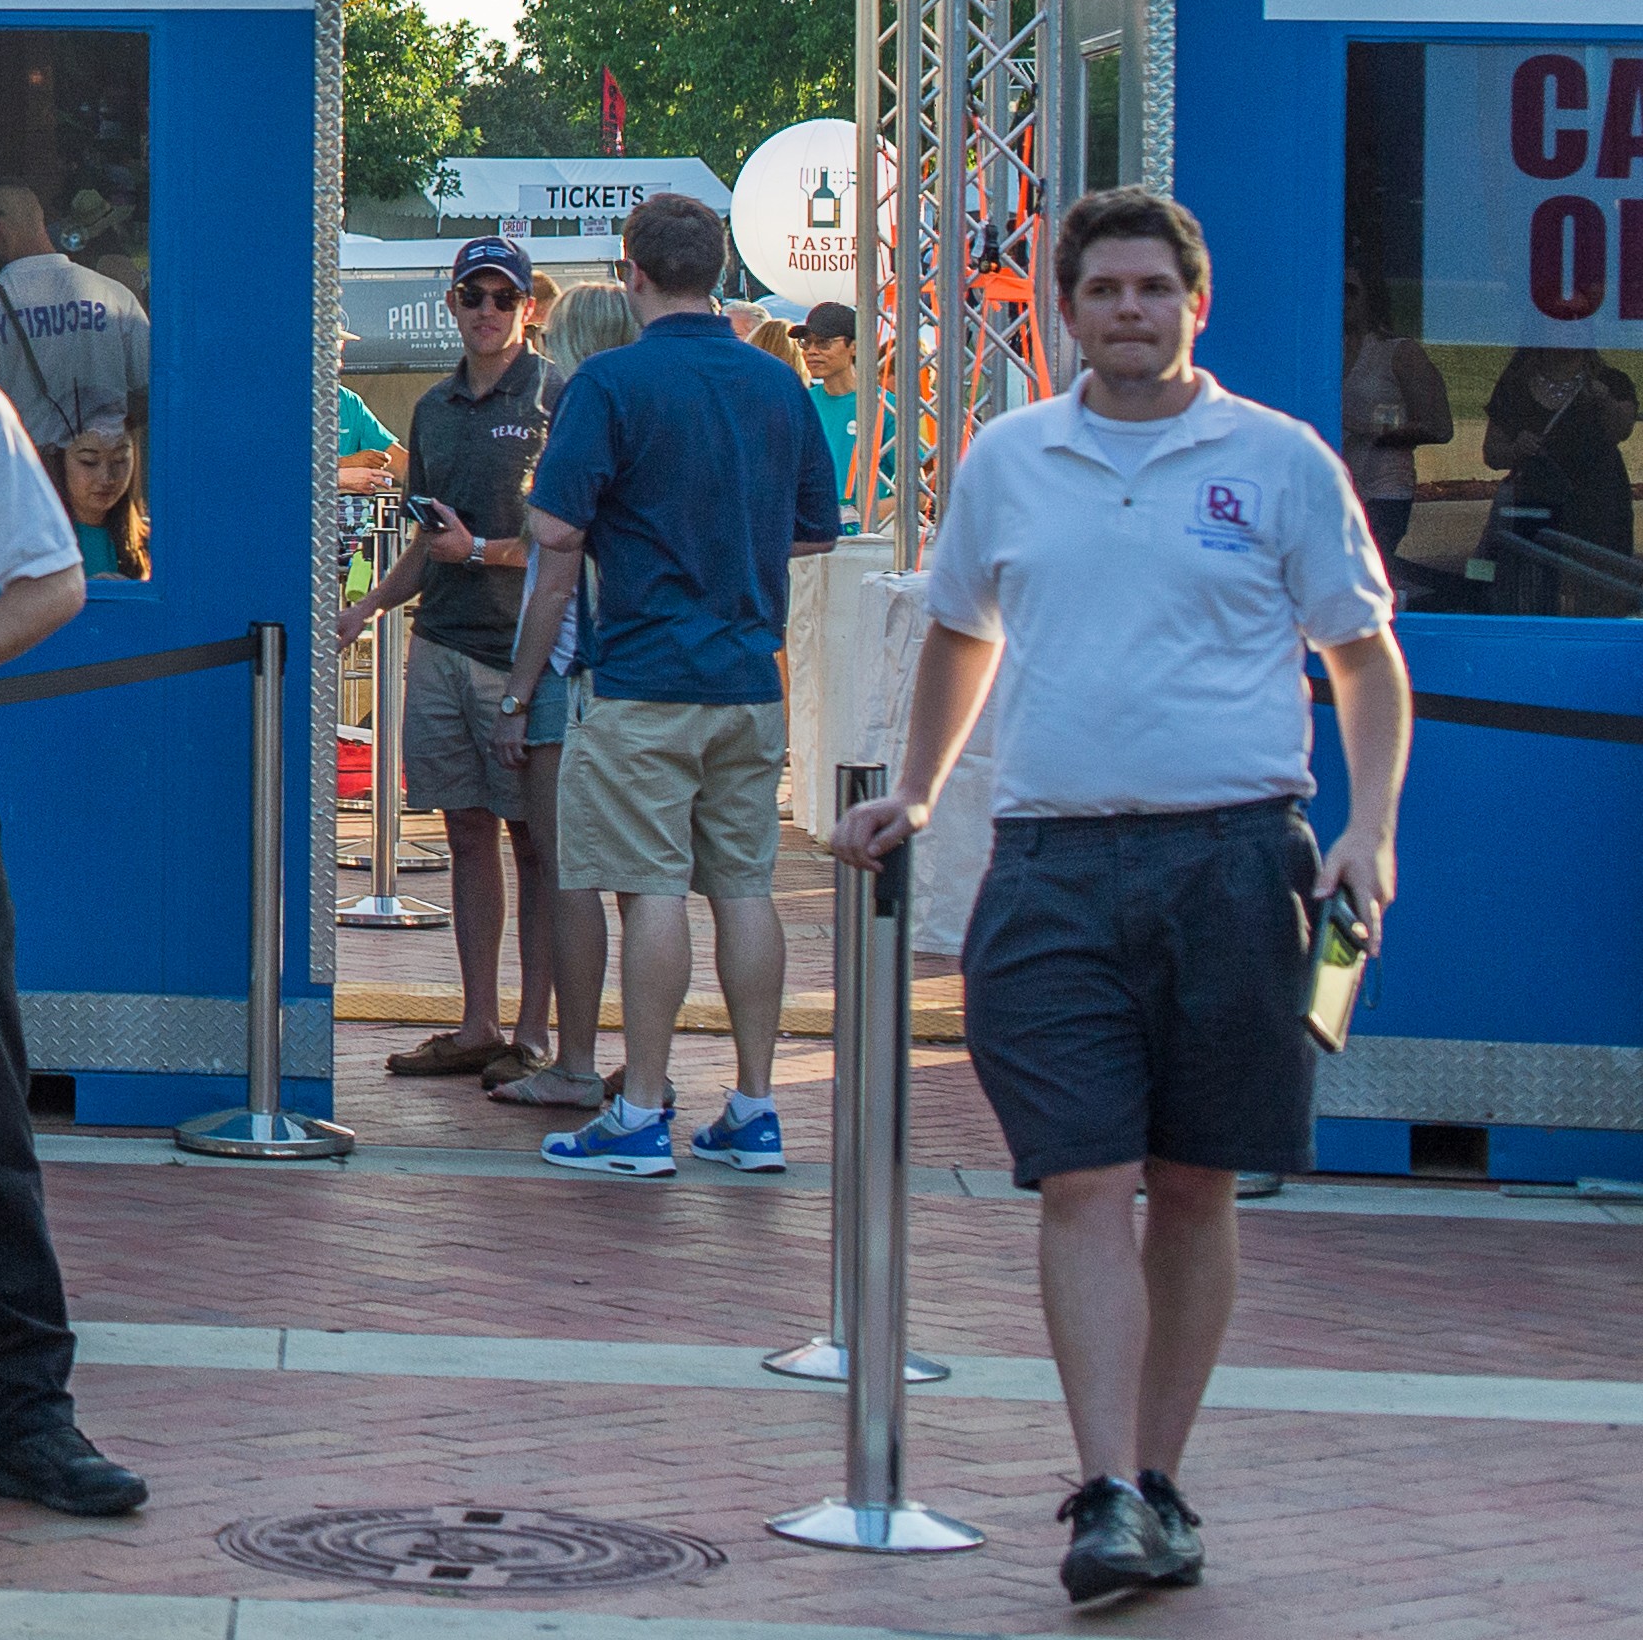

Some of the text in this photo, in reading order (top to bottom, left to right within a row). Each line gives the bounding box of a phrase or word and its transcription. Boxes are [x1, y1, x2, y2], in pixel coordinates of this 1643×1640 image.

[546, 185, 644, 209] TICKETS
[502, 220, 528, 233] CREDIT
[388, 300, 429, 330] PAN
[490, 424, 529, 440] TEXAS
